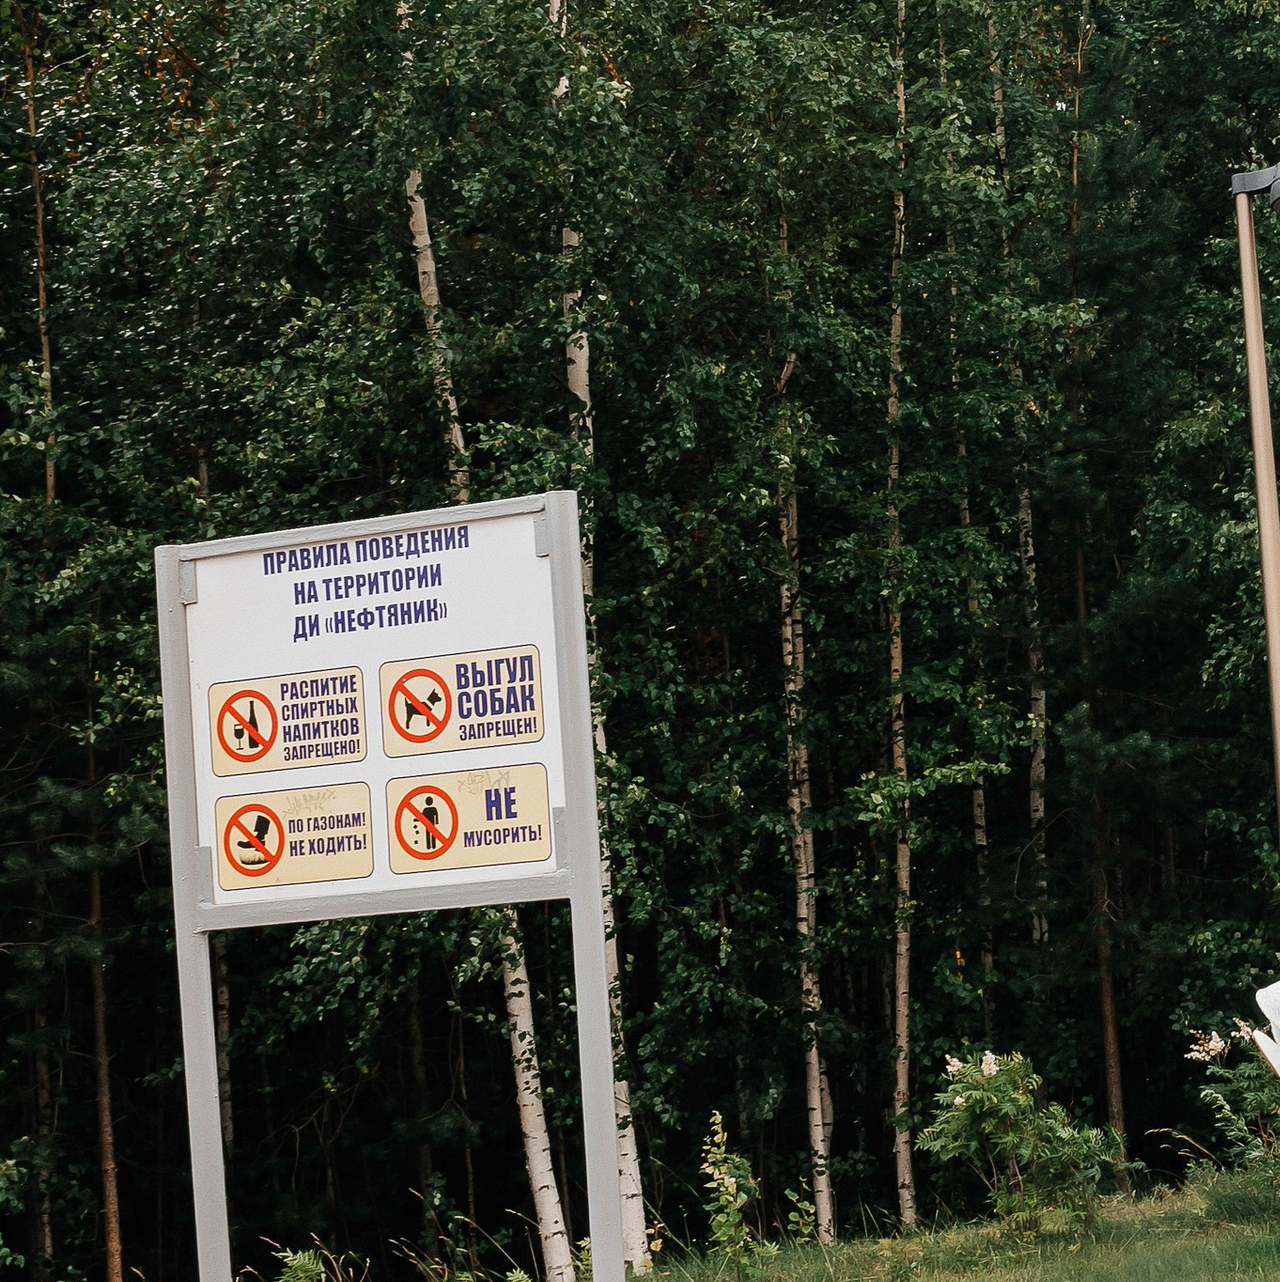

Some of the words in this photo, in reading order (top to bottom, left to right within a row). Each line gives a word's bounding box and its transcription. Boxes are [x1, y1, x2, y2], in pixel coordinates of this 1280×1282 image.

[263, 541, 352, 575] ПРАВИЛА
[355, 525, 470, 562] ПОВЕДЕНИЯ
[293, 581, 318, 605] НА
[322, 564, 442, 601] ТЕРРИТОРИИ
[293, 614, 321, 642] ДИ
[324, 599, 448, 635] «НЕФТЯНИК»
[455, 654, 534, 690] ВЫГУЛ
[280, 674, 358, 701] РАСПИТИЕ
[281, 696, 358, 721] СПИРТНЫХ
[457, 684, 536, 719] СОБАК
[282, 717, 360, 744] НАПИТКОВ
[459, 718, 538, 743] ЗАПРЕЩЕН!
[283, 739, 361, 761] ЗАПРЕЩЕНО!
[485, 787, 518, 821] НЕ
[288, 818, 304, 834] ПО
[306, 812, 366, 832] ГАЗОНАМ!
[463, 825, 542, 848] МУСОРИТЬ!
[289, 840, 306, 857] НЕ
[308, 834, 367, 856] ХОДИТЬ!
